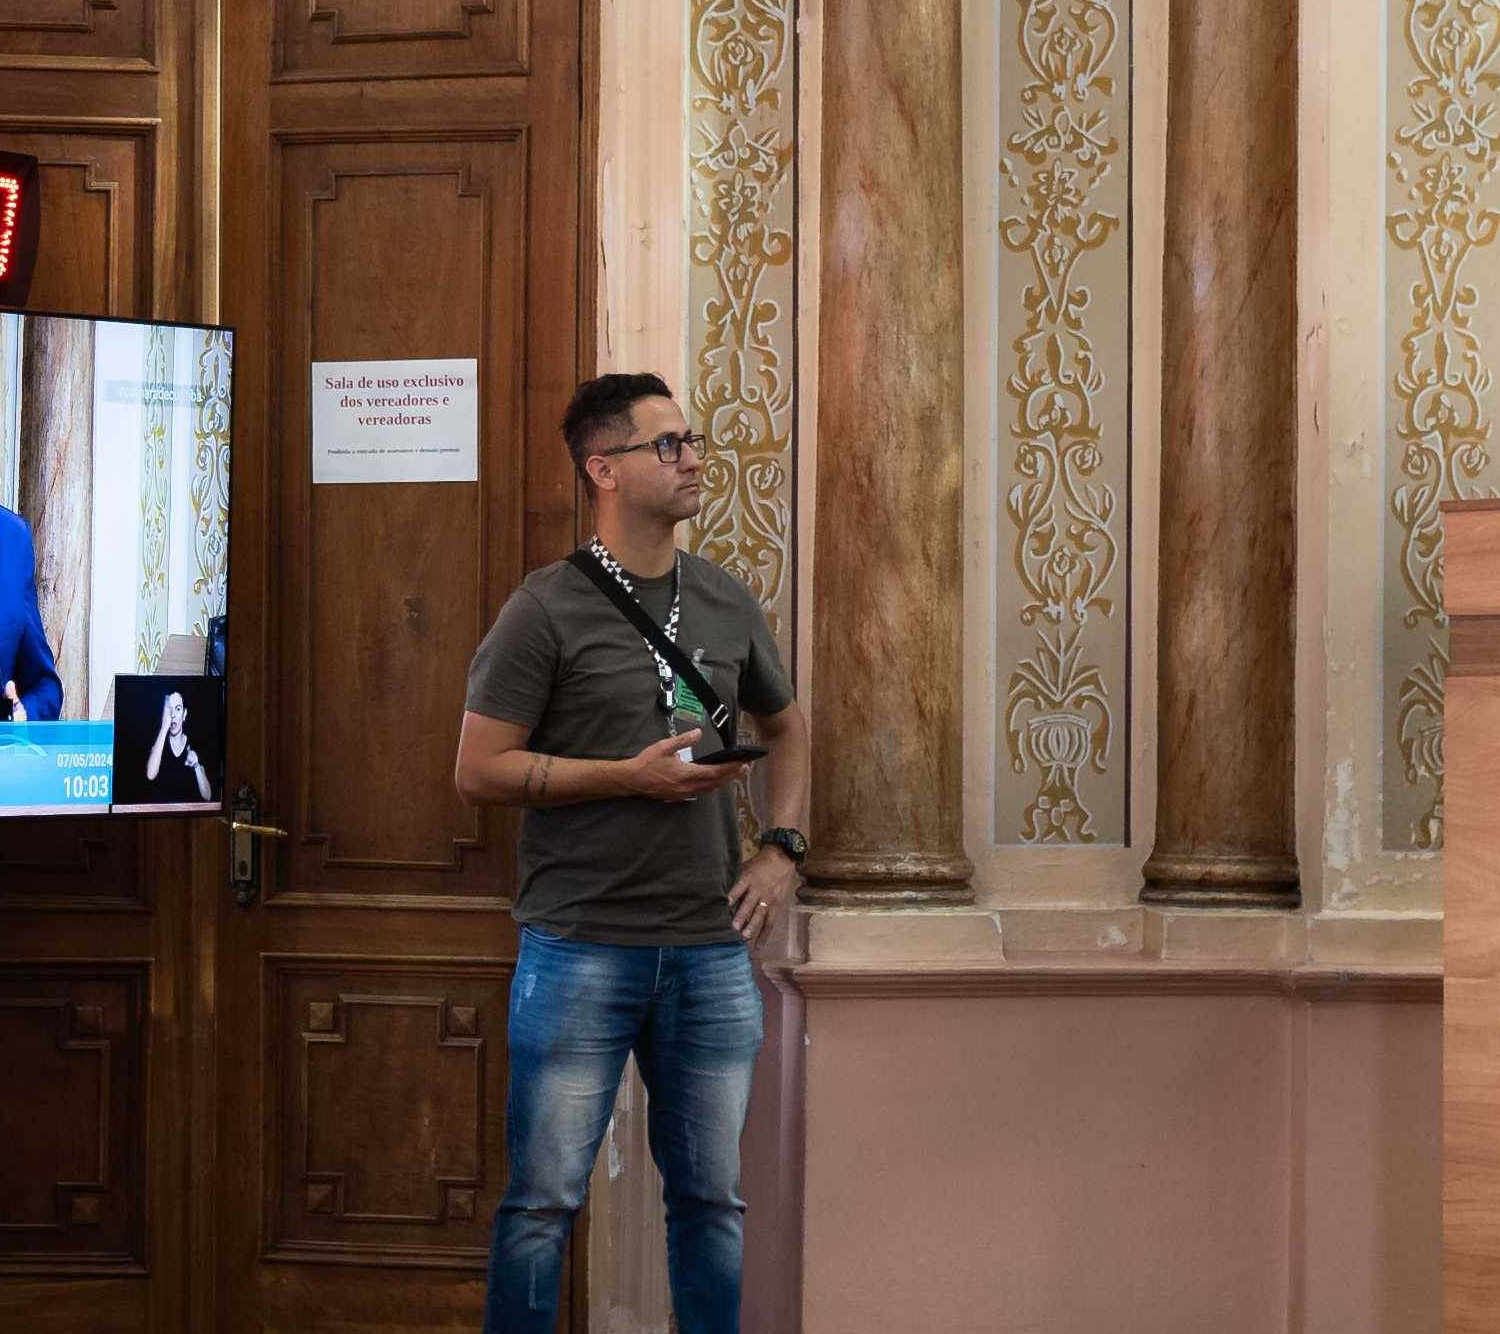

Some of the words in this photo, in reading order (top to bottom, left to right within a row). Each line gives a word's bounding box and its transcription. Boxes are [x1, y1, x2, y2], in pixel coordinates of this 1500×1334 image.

[325, 377, 354, 390] Sala
[357, 376, 373, 389] de
[377, 378, 399, 389] uso
[403, 374, 465, 388] exclusivo
[340, 395, 363, 408] dos
[366, 394, 439, 408] vereadores
[442, 396, 450, 406] e
[357, 413, 432, 426] vereadoras
[57, 753, 113, 769] 07/05/2024
[63, 775, 109, 799] 10:03
